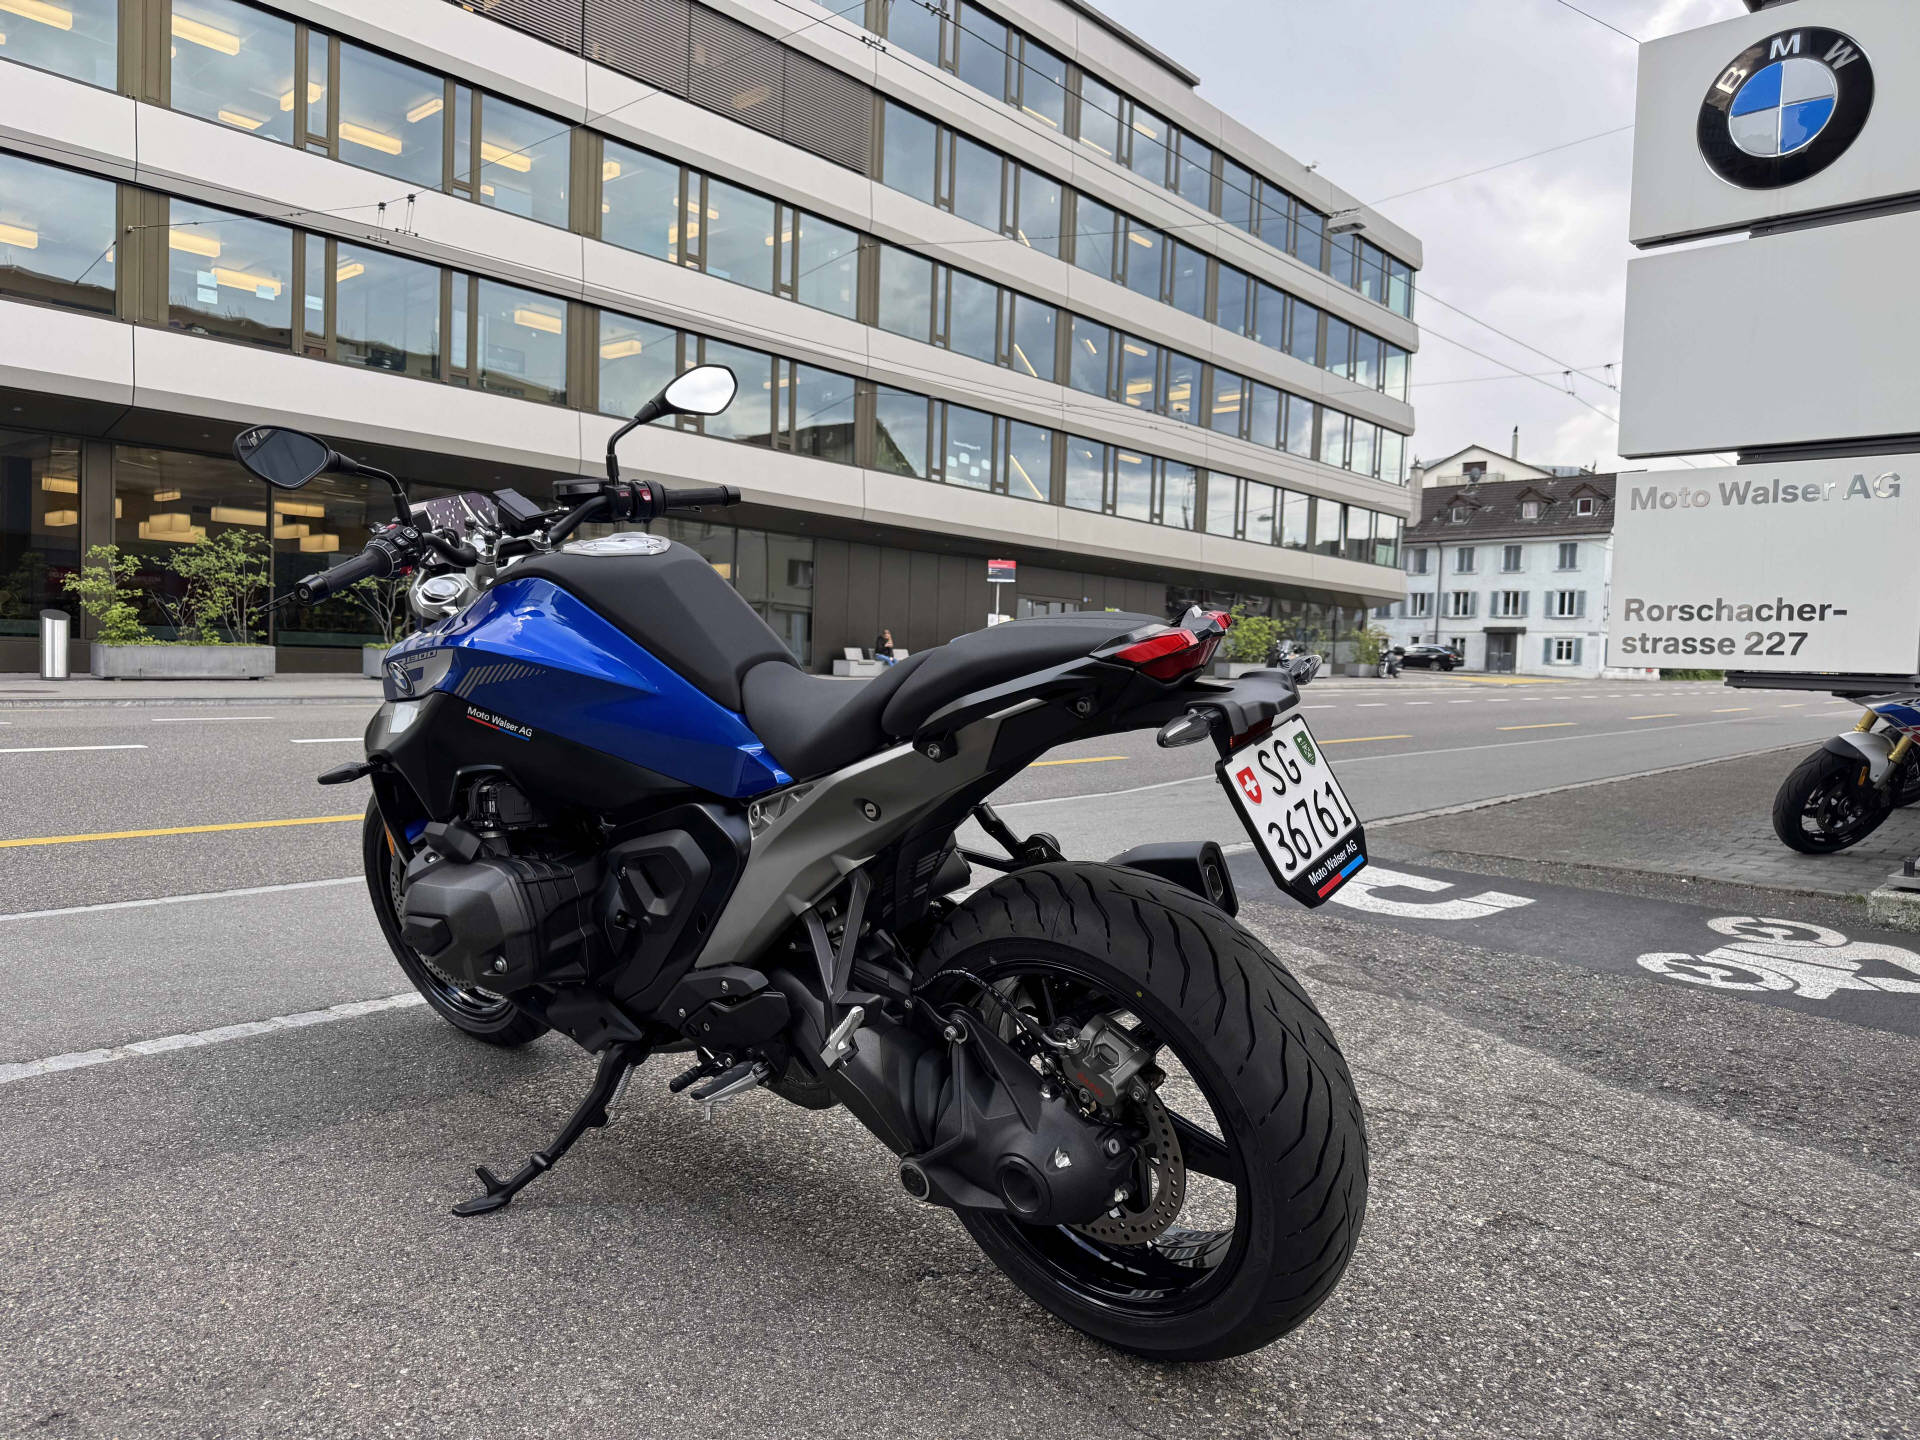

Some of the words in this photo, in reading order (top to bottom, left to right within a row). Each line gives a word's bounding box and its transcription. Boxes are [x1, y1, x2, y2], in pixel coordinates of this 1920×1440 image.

[1715, 32, 1859, 95] BMW
[1630, 486, 1711, 511] Moto
[1718, 479, 1836, 506] Walser
[1842, 471, 1901, 500] AG
[1624, 597, 1848, 622] Rorschacher-
[1621, 632, 1736, 655] strasse
[1743, 631, 1808, 656] 227
[467, 706, 490, 721] Moto
[491, 714, 519, 732] Walser
[518, 726, 533, 737] AG
[1258, 740, 1302, 795] SG
[1268, 781, 1352, 871] 36761
[1308, 867, 1328, 886] Moto
[1324, 850, 1347, 871] Walser
[1345, 839, 1358, 855] AG
